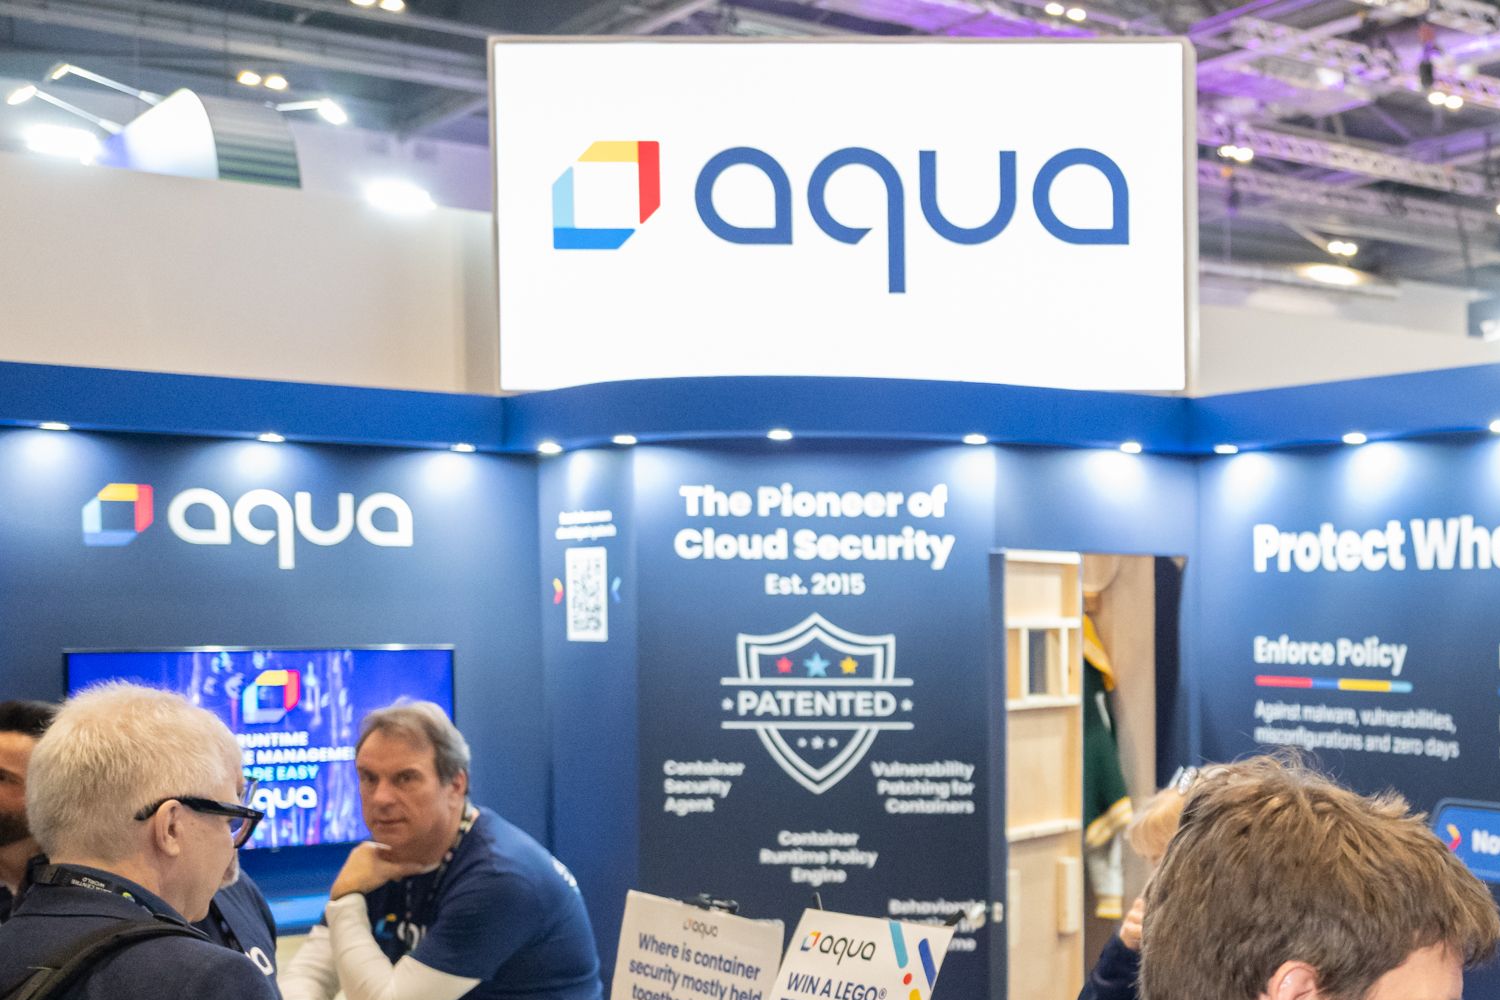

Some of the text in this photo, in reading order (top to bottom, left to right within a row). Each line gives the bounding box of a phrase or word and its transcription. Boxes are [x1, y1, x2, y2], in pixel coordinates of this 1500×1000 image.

[695, 146, 1131, 293] aqua
[679, 482, 948, 518] The Pioneer of
[168, 487, 414, 569] aqua
[674, 525, 956, 571] Cloud Security
[1253, 521, 1406, 573] Protect
[765, 572, 866, 596] Est. 2015
[1254, 633, 1407, 676] Enforce Policy
[737, 690, 898, 717] PATENTED
[1255, 700, 1301, 723] Against
[1365, 734, 1391, 751] and
[1393, 738, 1423, 755] zero
[1425, 738, 1459, 761] days
[276, 765, 319, 781] EASY
[663, 759, 746, 777] Container
[870, 760, 975, 781] Vulnerability
[664, 777, 733, 798] Security
[877, 779, 975, 800] Patching for
[250, 785, 318, 818] qua
[664, 796, 715, 817] Agent
[884, 798, 976, 815] Containers
[777, 829, 860, 847] Container
[759, 847, 879, 869] Runtime Policy
[791, 866, 847, 887] Engine
[691, 919, 718, 939] aqua
[638, 933, 760, 981] Where is container
[819, 934, 876, 966] aqua
[629, 957, 680, 989] security
[681, 971, 729, 1000] mostly
[786, 971, 821, 995] WIN
[819, 977, 832, 998] A
